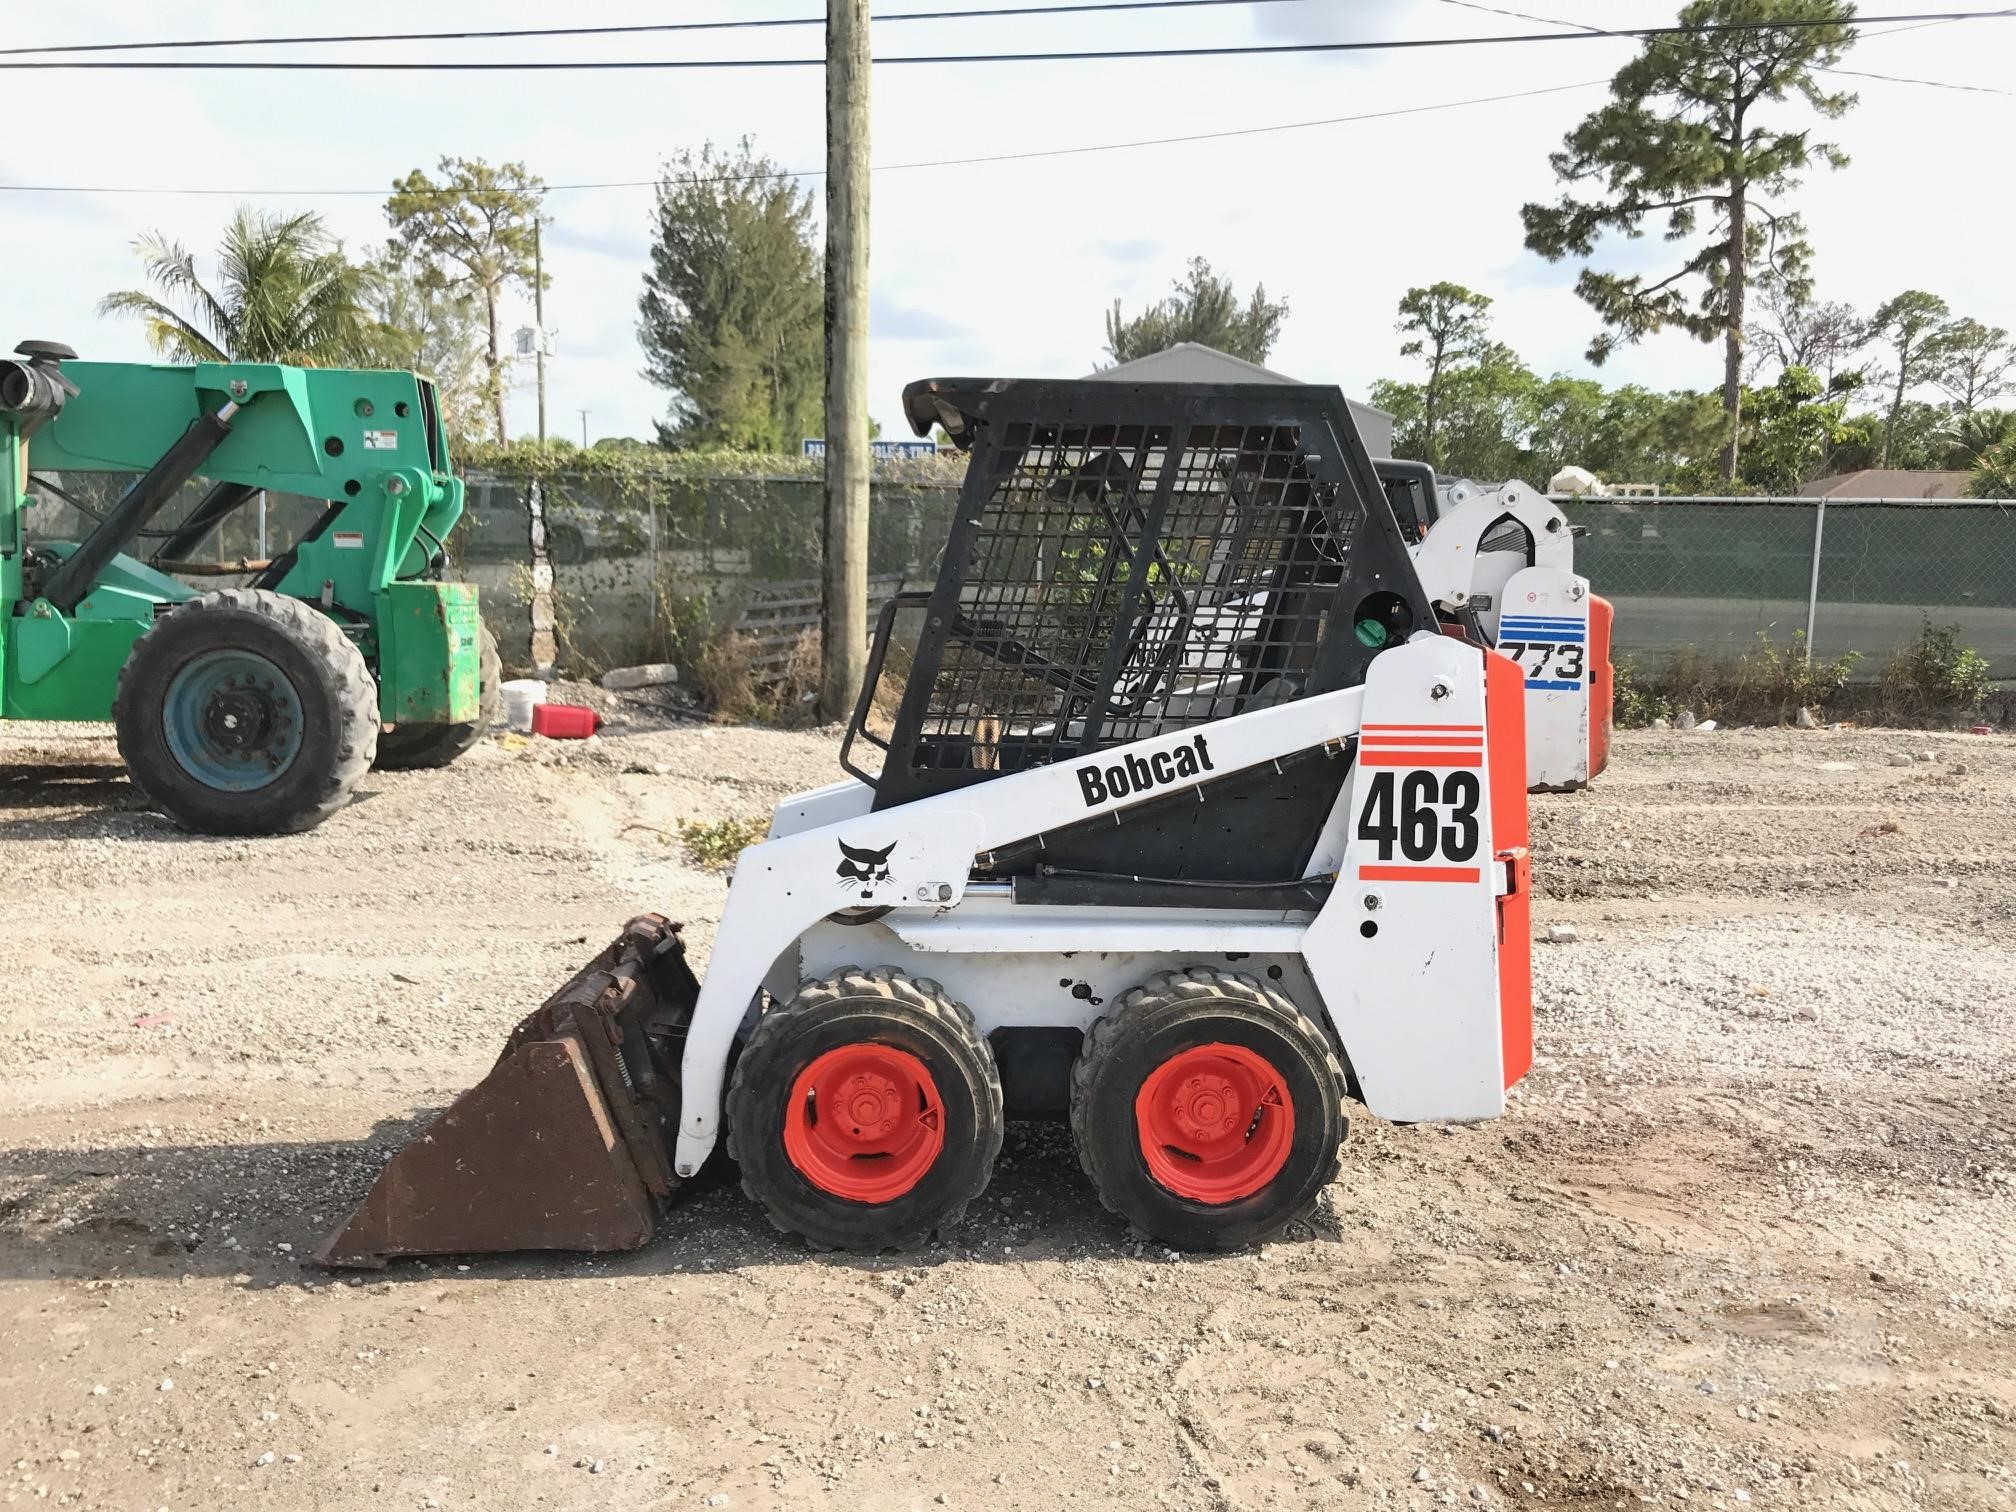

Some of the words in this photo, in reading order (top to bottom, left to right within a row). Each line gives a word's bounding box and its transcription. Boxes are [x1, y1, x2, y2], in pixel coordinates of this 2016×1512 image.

[1498, 642, 1585, 679] 773
[1076, 733, 1215, 807] Bobcat
[1357, 769, 1480, 863] 463
